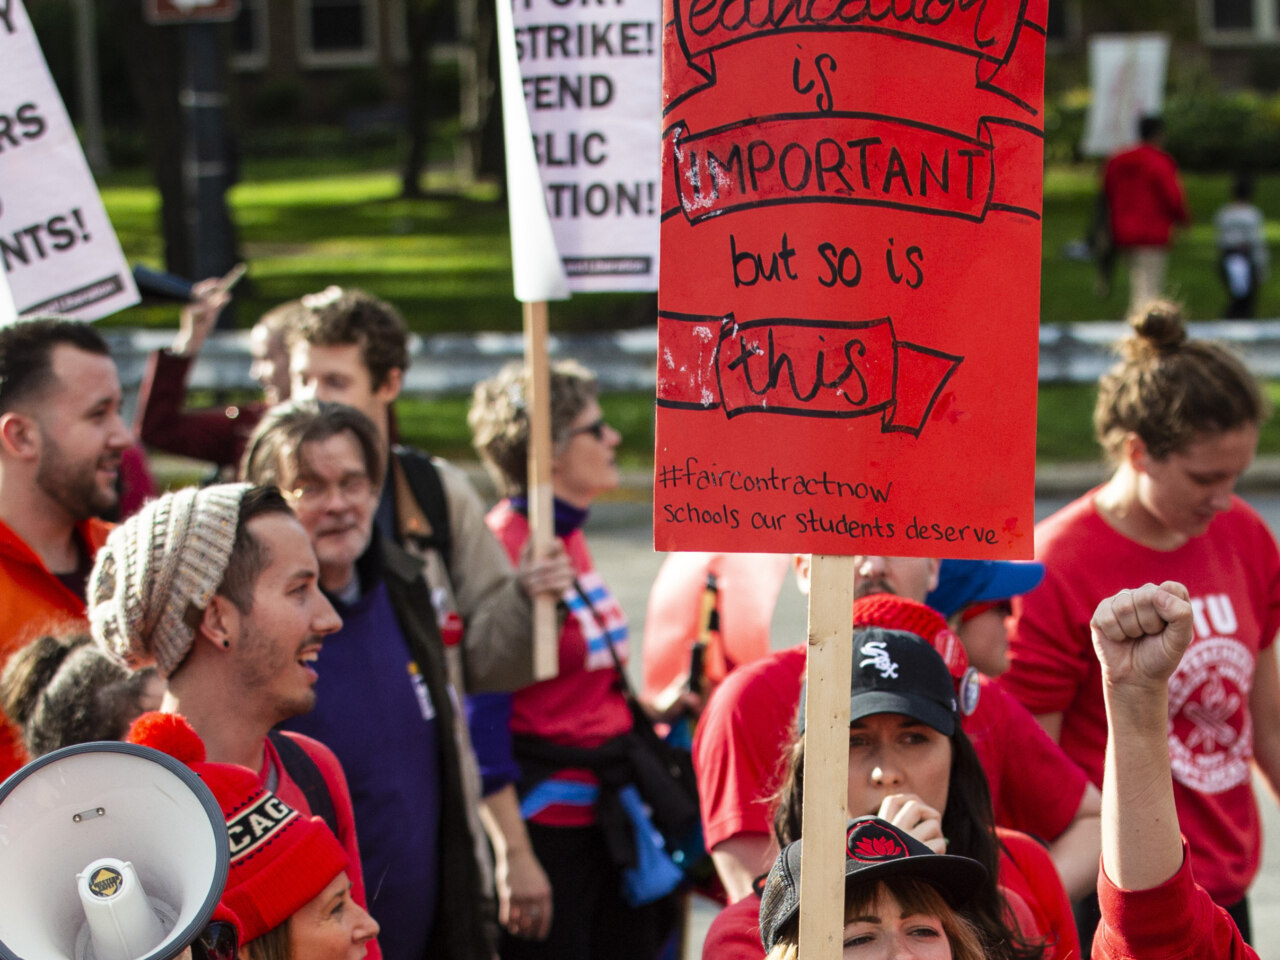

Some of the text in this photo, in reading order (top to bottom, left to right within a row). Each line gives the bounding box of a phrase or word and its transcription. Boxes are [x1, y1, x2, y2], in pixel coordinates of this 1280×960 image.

[792, 43, 838, 112] is
[690, 137, 985, 200] IMPORTANT
[729, 232, 924, 289] but so is
[728, 328, 868, 405] this
[659, 458, 893, 503] #faircontractnow
[751, 511, 787, 531] our
[906, 516, 999, 544] deserve
